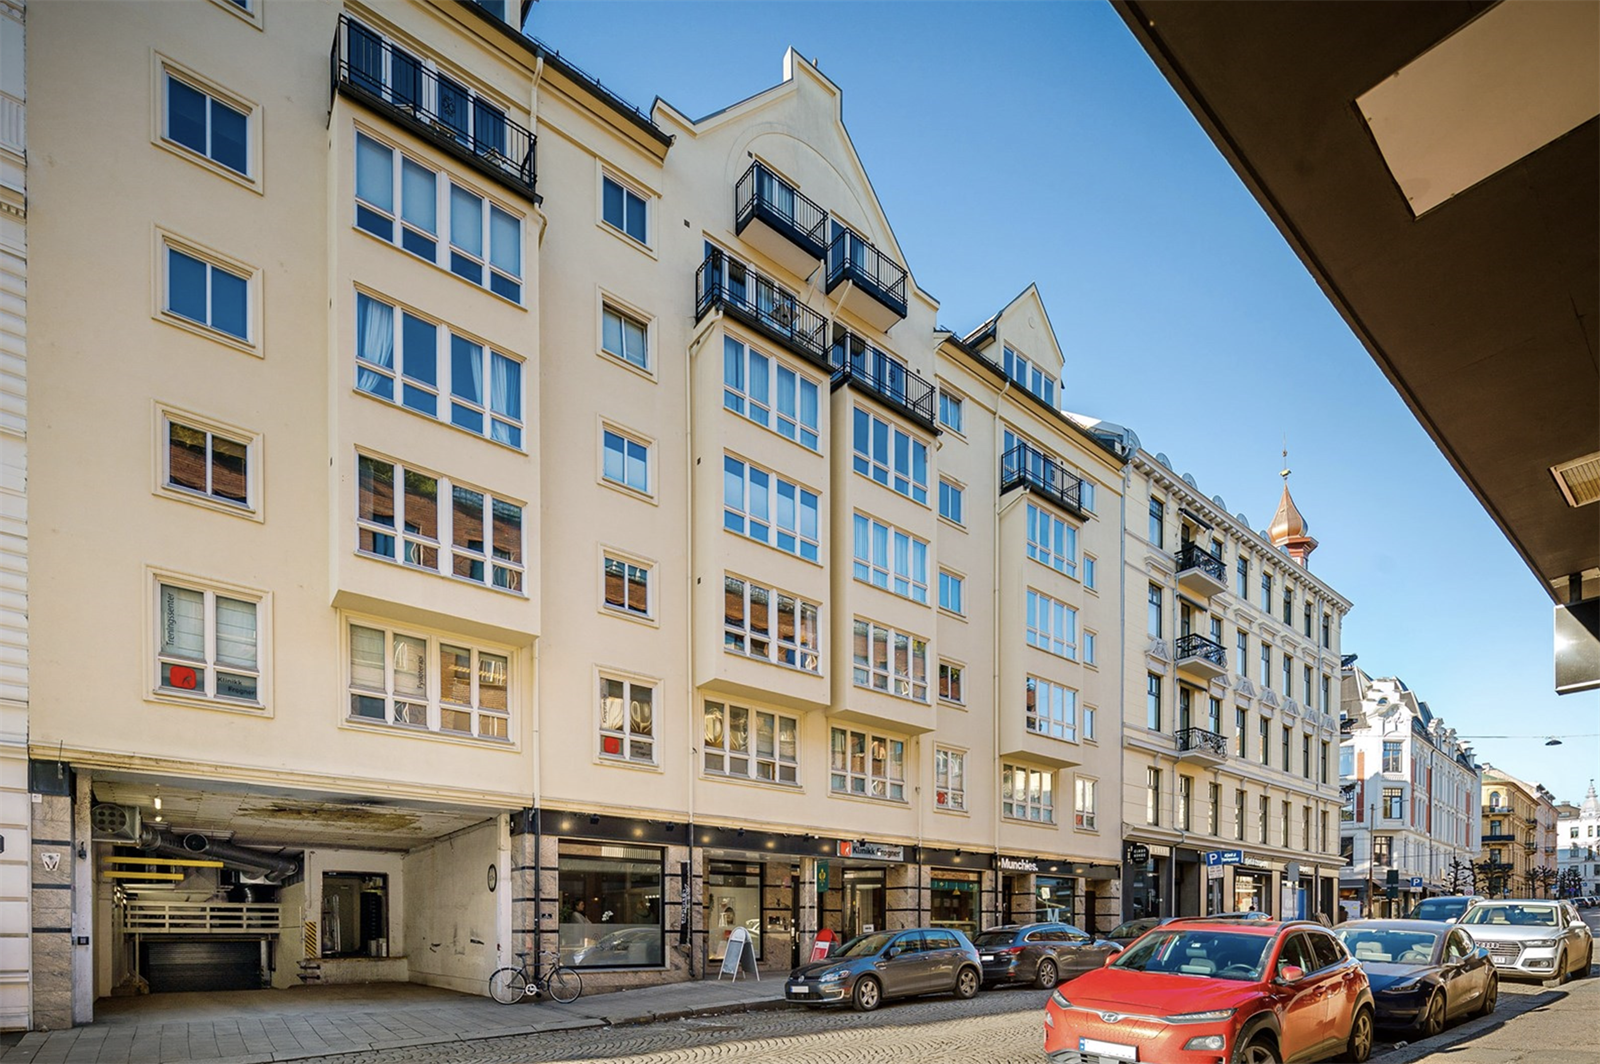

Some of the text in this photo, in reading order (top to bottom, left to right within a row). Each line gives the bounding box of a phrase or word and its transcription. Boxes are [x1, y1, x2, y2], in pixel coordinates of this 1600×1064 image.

[166, 593, 176, 646] Treningssenter
[1209, 853, 1218, 864] P
[1413, 878, 1420, 886] P
